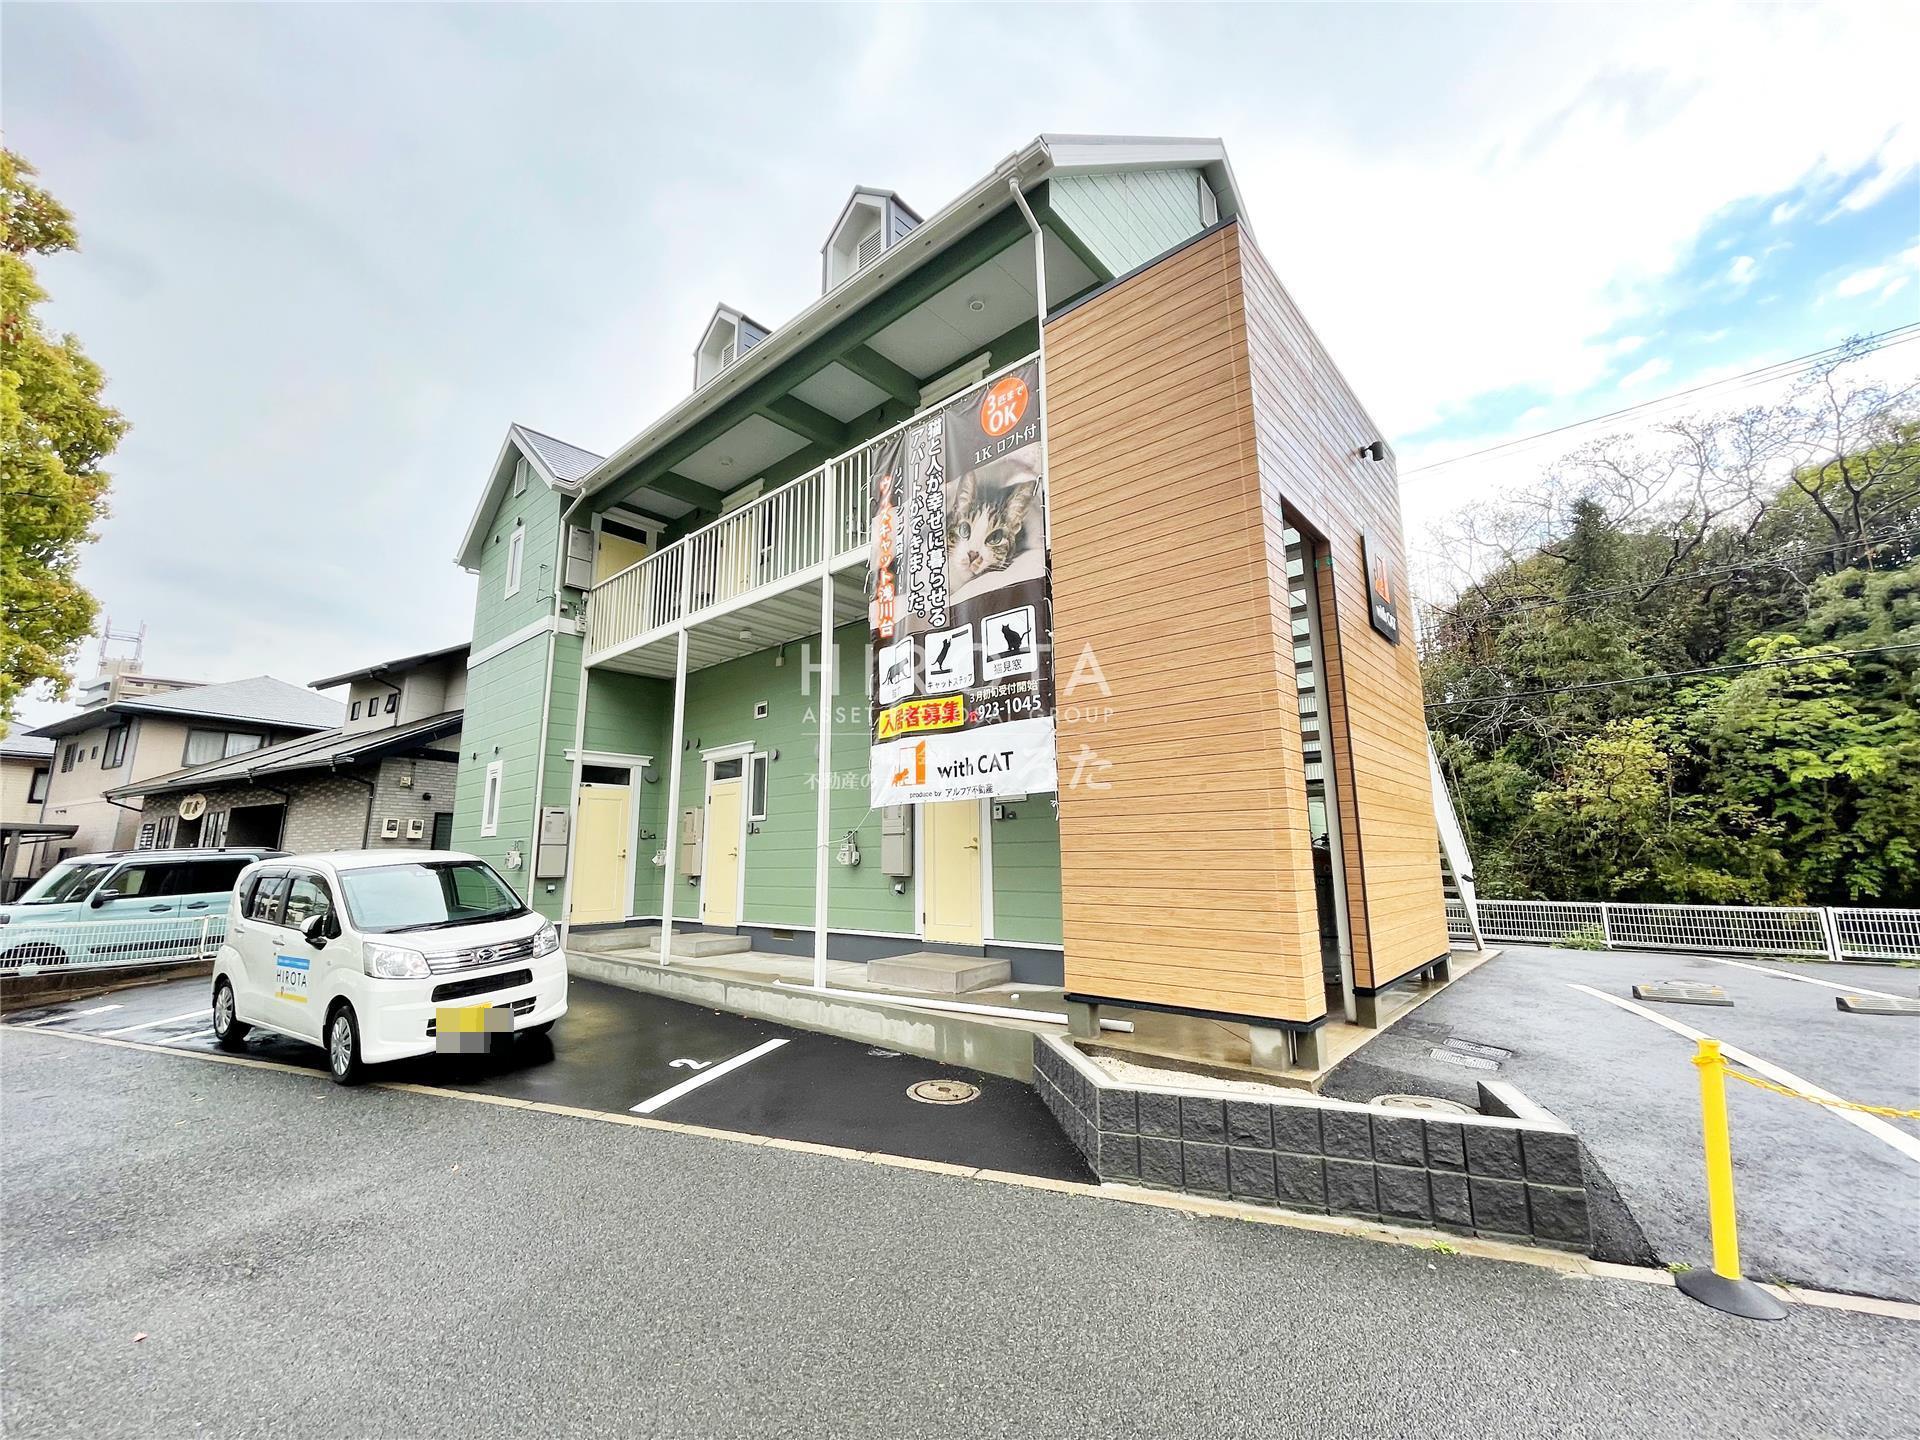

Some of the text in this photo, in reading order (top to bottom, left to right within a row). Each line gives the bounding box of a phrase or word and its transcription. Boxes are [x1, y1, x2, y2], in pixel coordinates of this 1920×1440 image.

[989, 403, 1018, 433] OK
[974, 424, 1036, 464] 1K ロフト付
[908, 428, 926, 617] アパートができました。
[926, 416, 947, 627] 猫と人が幸せに暮らせる
[881, 700, 960, 735] 入居者募集
[978, 695, 1042, 720] 923-1045
[937, 751, 1014, 778] with CAT
[276, 970, 307, 988] HIROTA
[668, 1058, 713, 1070] 2
